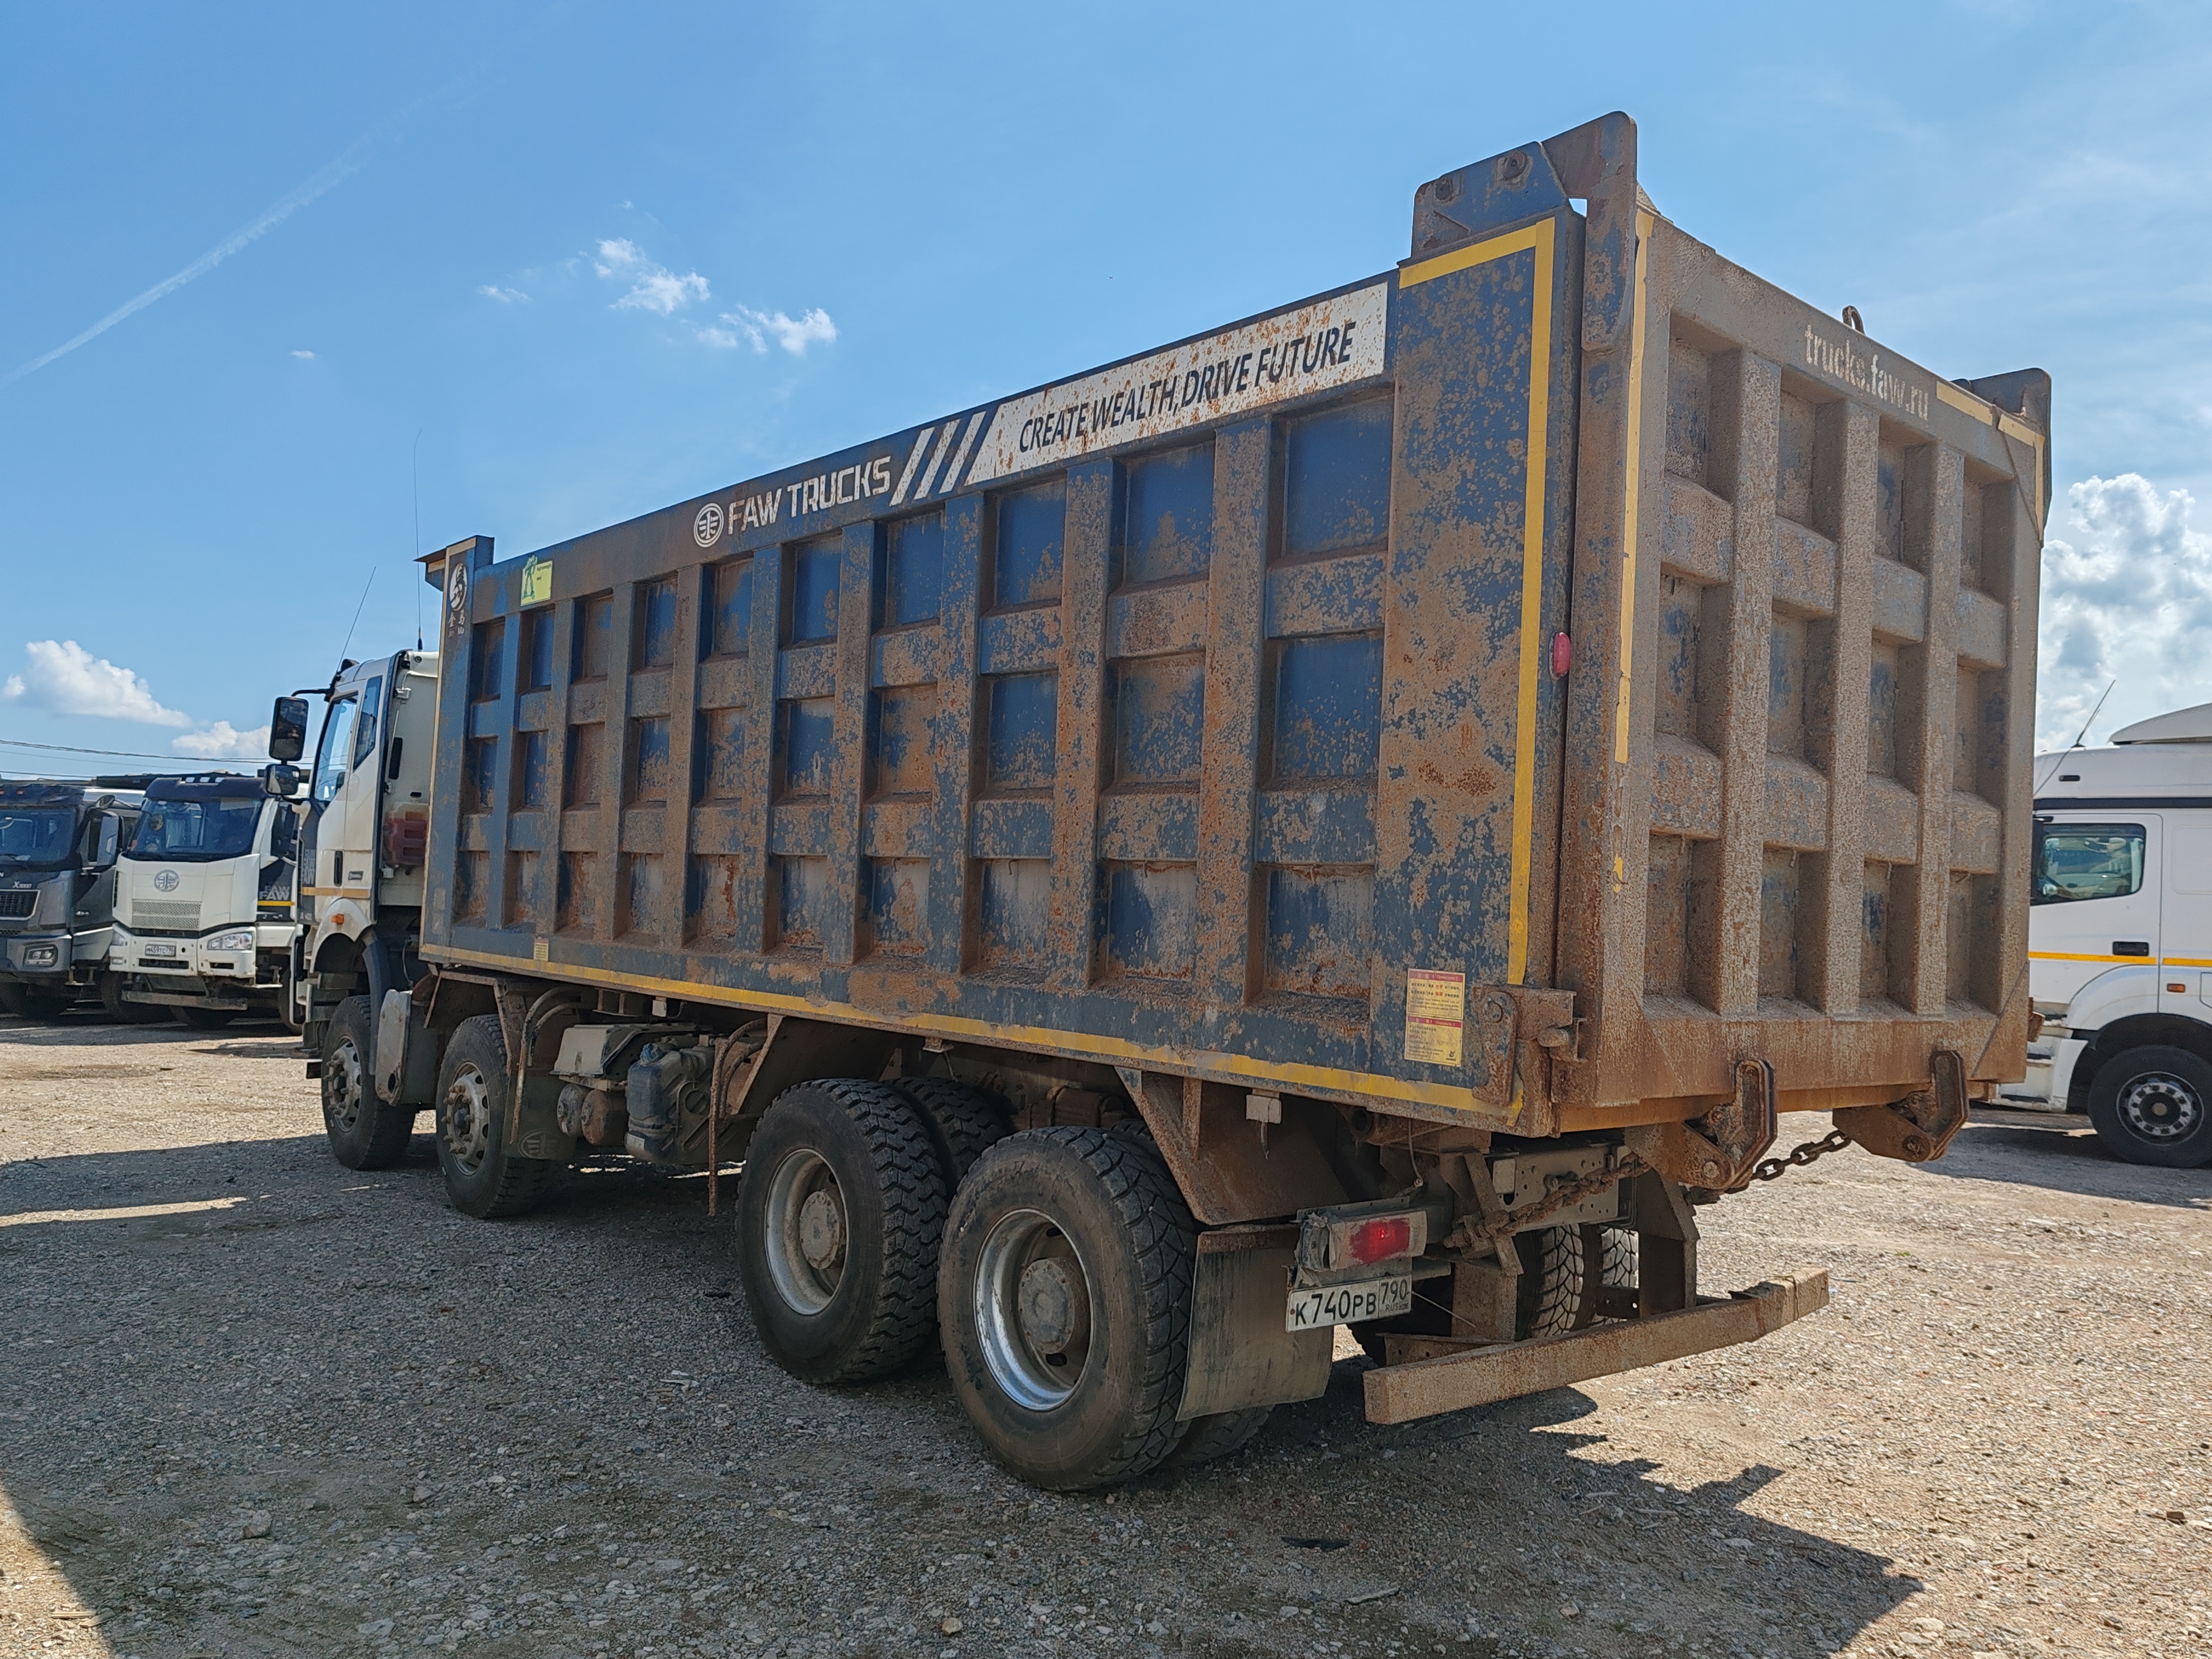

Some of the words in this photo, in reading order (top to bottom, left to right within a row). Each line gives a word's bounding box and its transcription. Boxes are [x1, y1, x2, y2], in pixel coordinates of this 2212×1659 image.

[1019, 403, 1089, 452] CREATE
[1255, 322, 1356, 387] FUTURE
[1805, 324, 1928, 421] trucks.faw.ru
[727, 488, 783, 535] FAW
[787, 456, 892, 518] TRUCKS
[259, 891, 290, 900] FAW
[1381, 1279, 1408, 1305] 790
[1386, 1302, 1399, 1312] RUS
